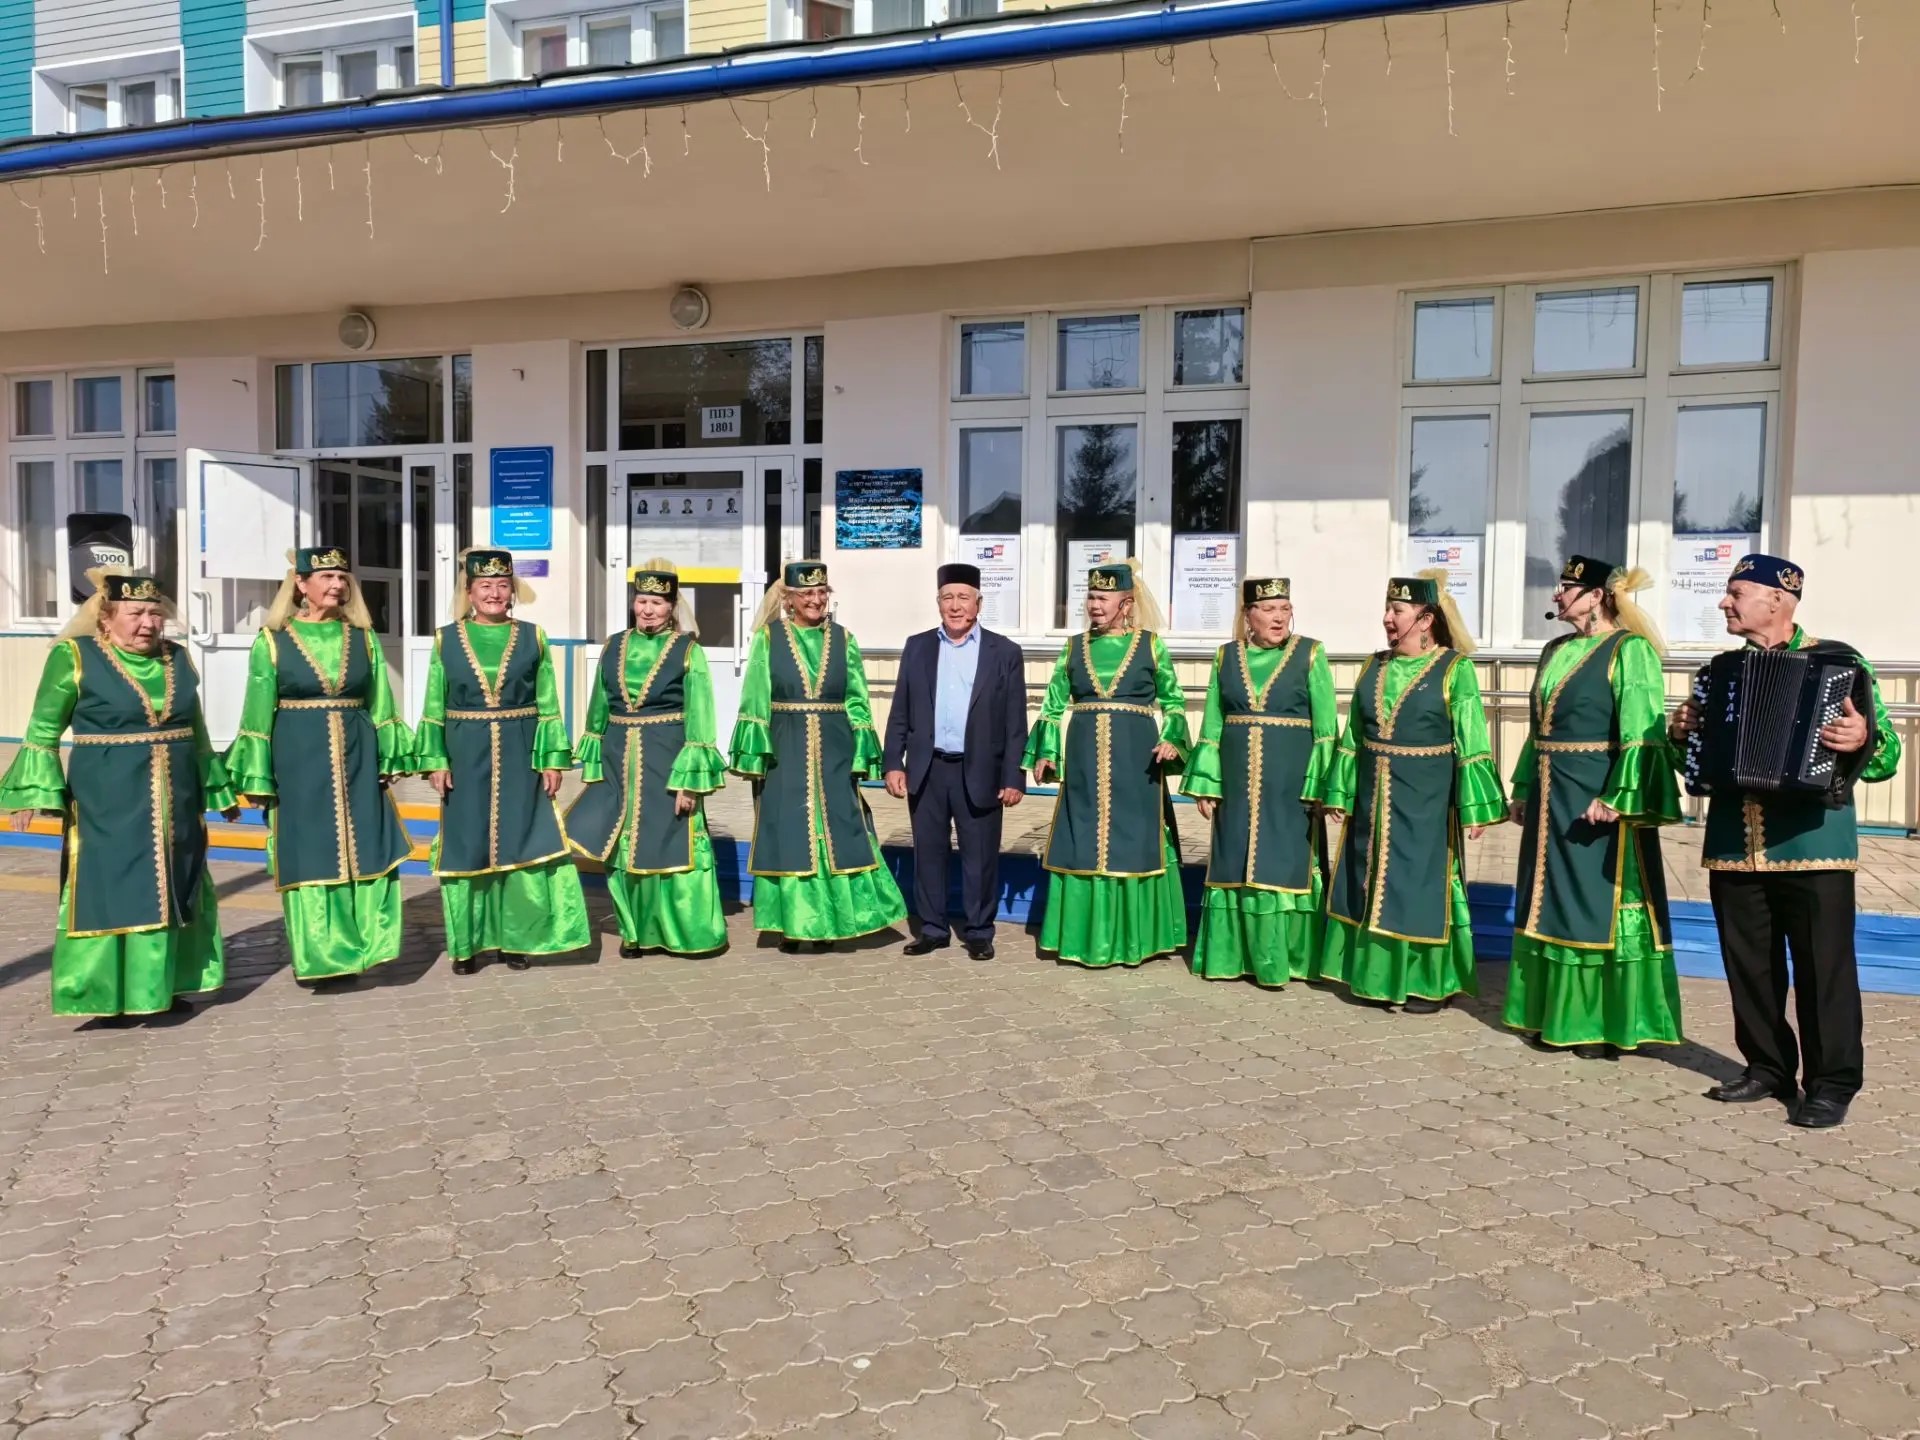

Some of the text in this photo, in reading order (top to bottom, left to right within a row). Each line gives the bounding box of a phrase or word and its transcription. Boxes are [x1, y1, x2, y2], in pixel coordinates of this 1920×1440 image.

[710, 408, 734, 419] ППЭ
[711, 422, 733, 432] 1801
[94, 553, 125, 563] 1000
[1428, 556, 1437, 564] 18
[1694, 555, 1704, 563] 18
